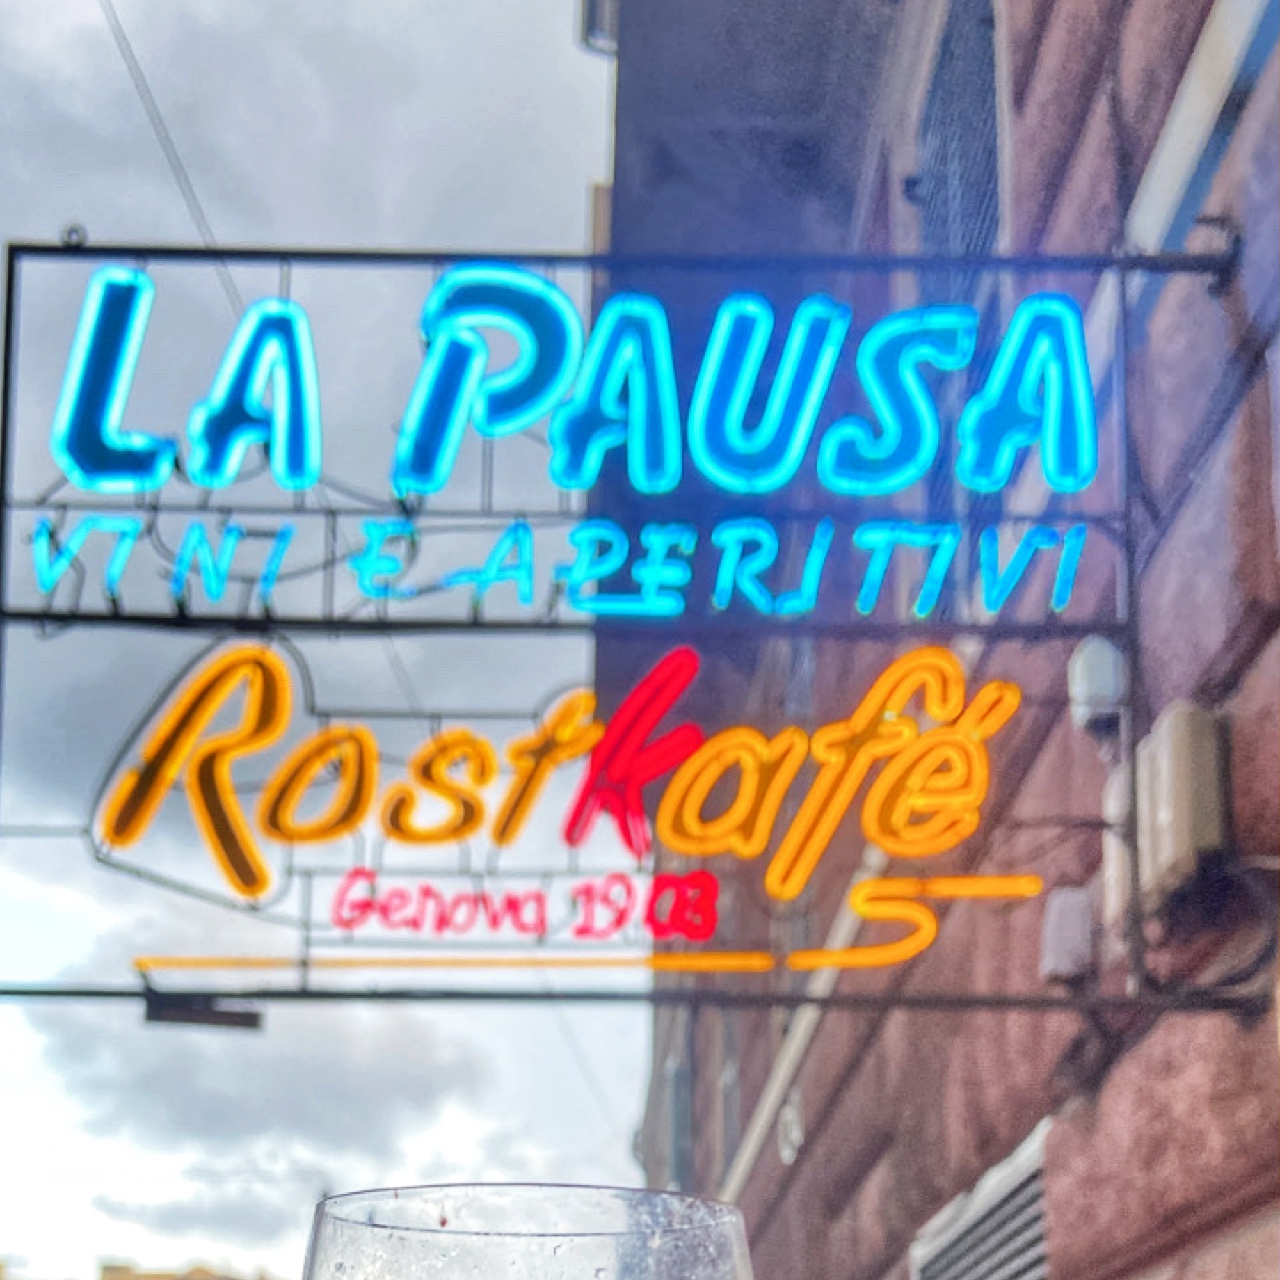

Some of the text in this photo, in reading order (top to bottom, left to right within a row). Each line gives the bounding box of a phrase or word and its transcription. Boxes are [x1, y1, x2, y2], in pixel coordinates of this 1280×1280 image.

[48, 259, 1099, 498] LA PAUSA
[31, 514, 1088, 617] VINI E APERITIVI
[330, 867, 549, 938] Genova
